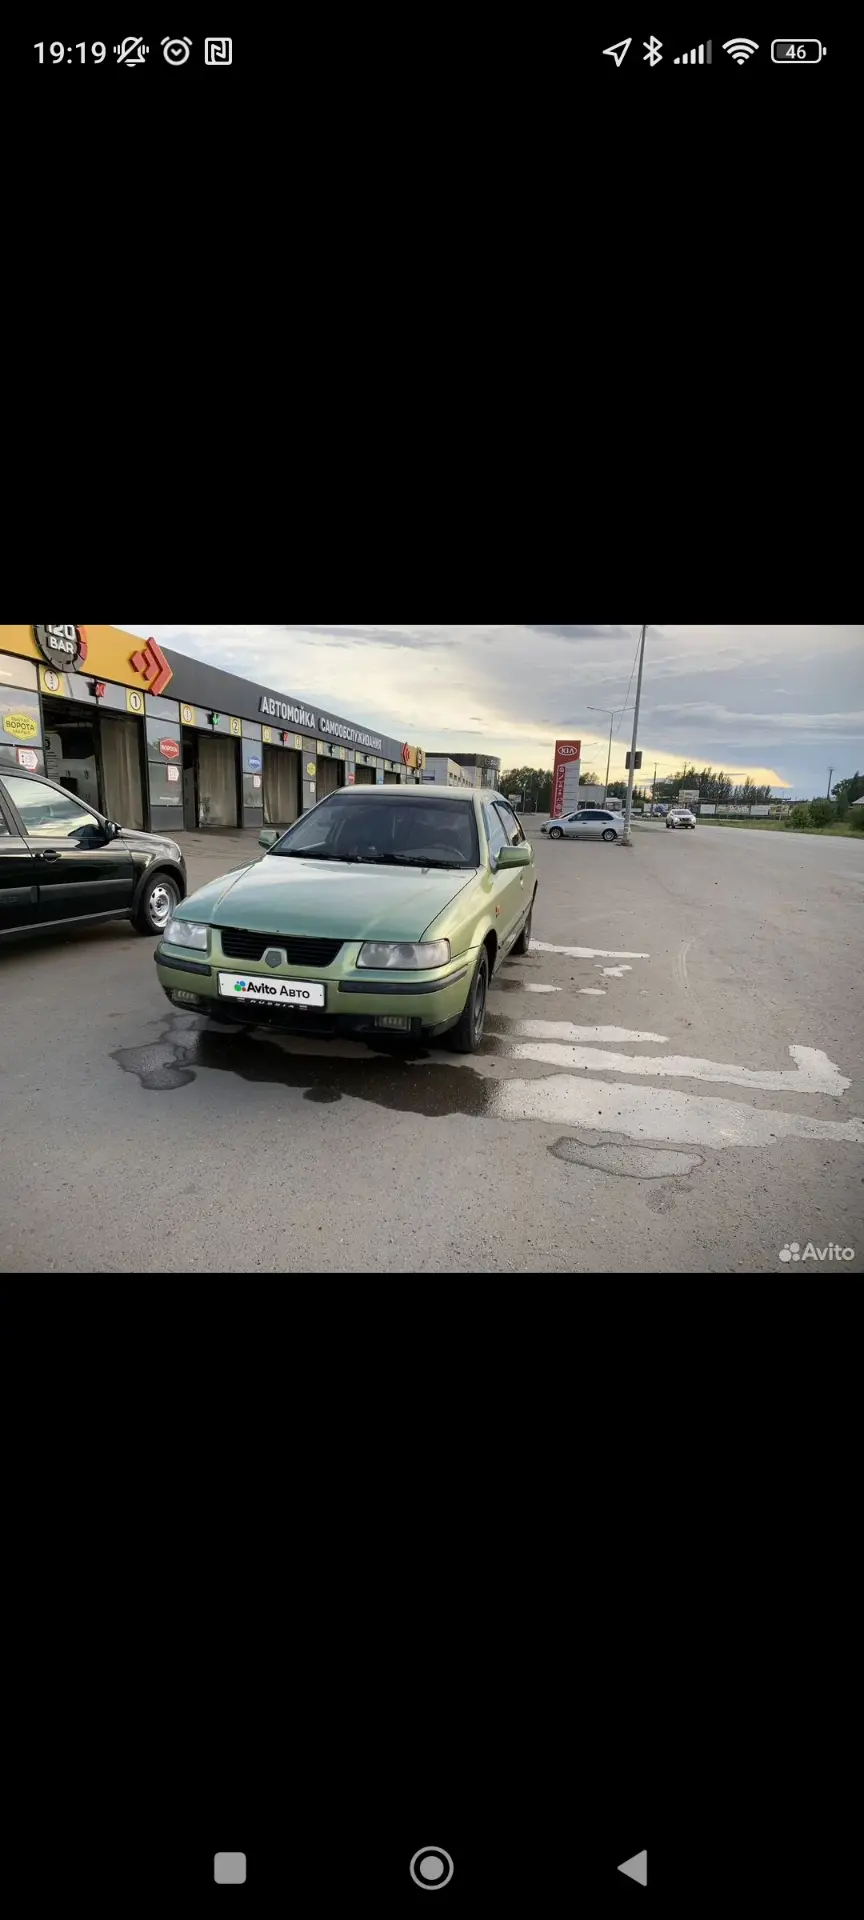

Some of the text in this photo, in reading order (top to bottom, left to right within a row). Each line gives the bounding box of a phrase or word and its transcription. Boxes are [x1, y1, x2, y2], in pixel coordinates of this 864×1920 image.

[50, 637, 75, 654] BAR
[133, 695, 138, 707] 1
[6, 720, 35, 731] ВОРОТА
[233, 721, 239, 731] 2
[260, 696, 382, 751] АВТОМОЙКА САМООБСЛУЖИВАНИЯ
